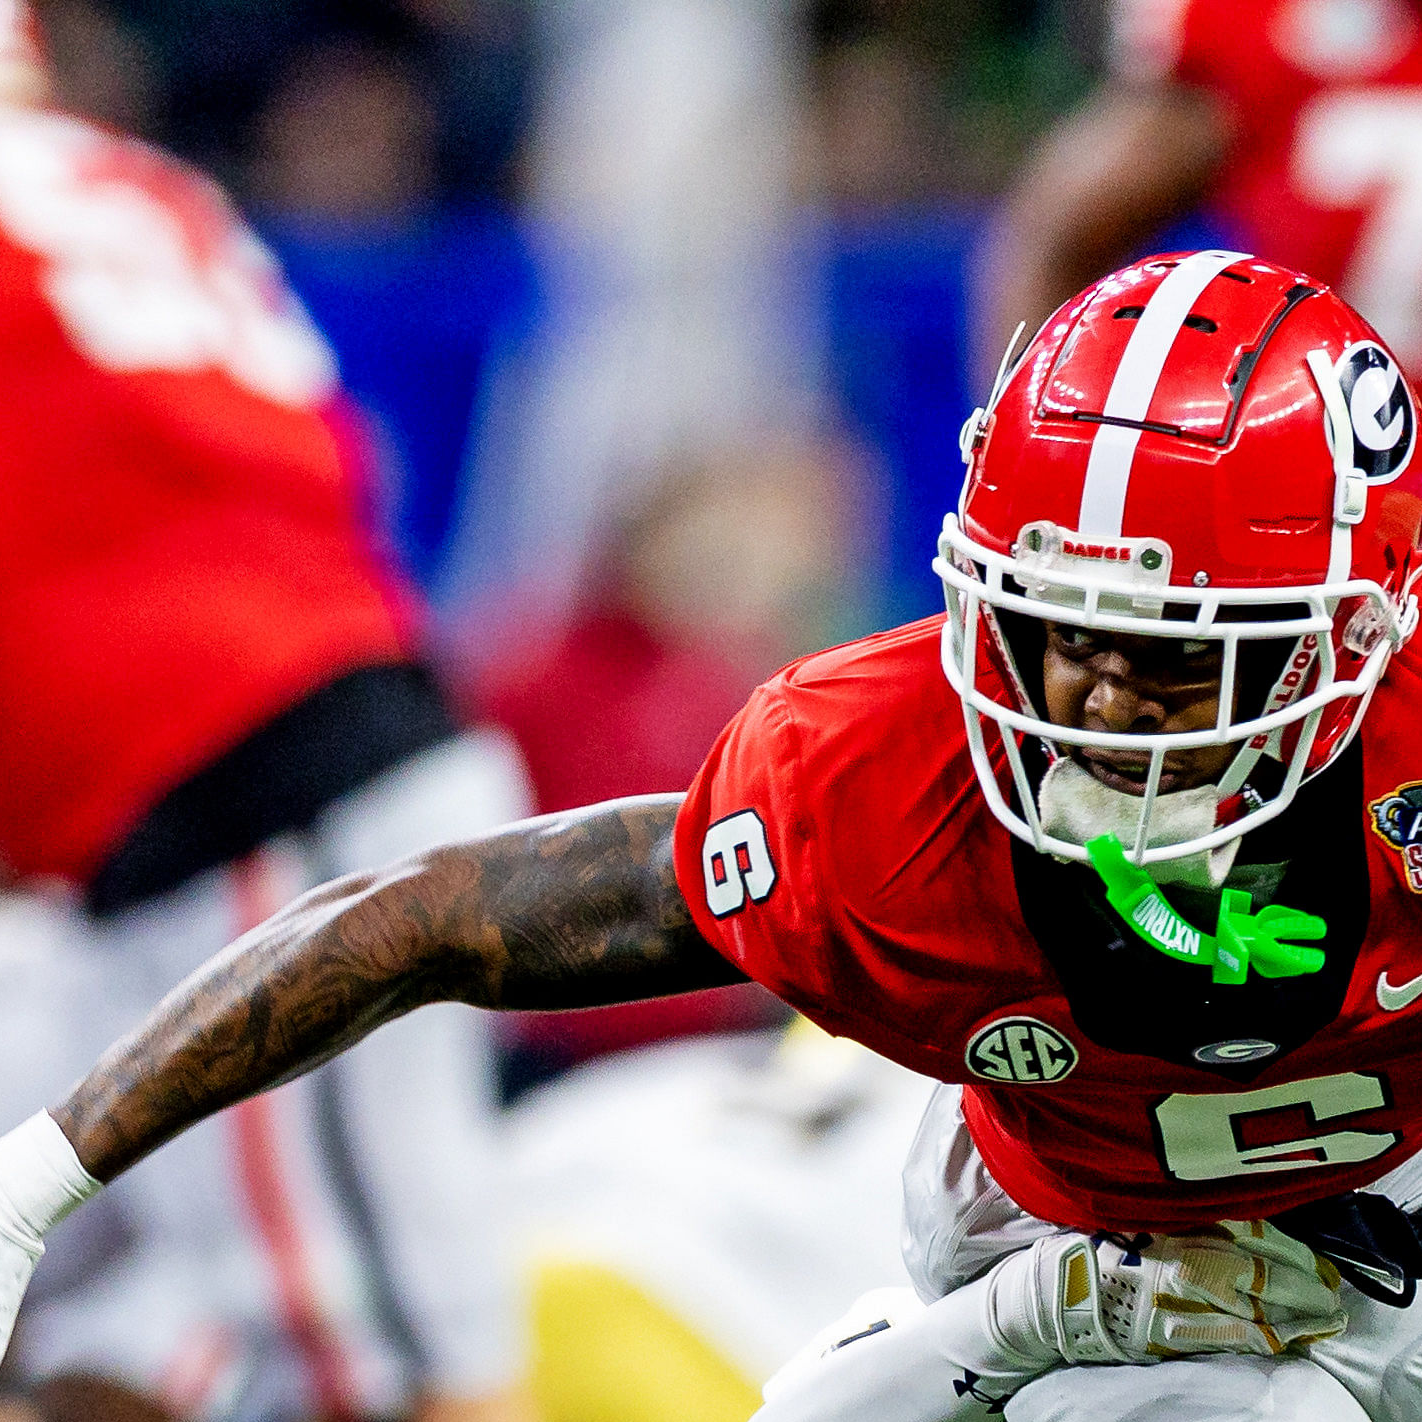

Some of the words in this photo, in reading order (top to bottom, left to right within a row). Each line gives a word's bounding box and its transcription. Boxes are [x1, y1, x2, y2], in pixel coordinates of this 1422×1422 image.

[702, 807, 776, 919] 6
[975, 1025, 1069, 1080] SEC
[1148, 1071, 1402, 1181] 6
